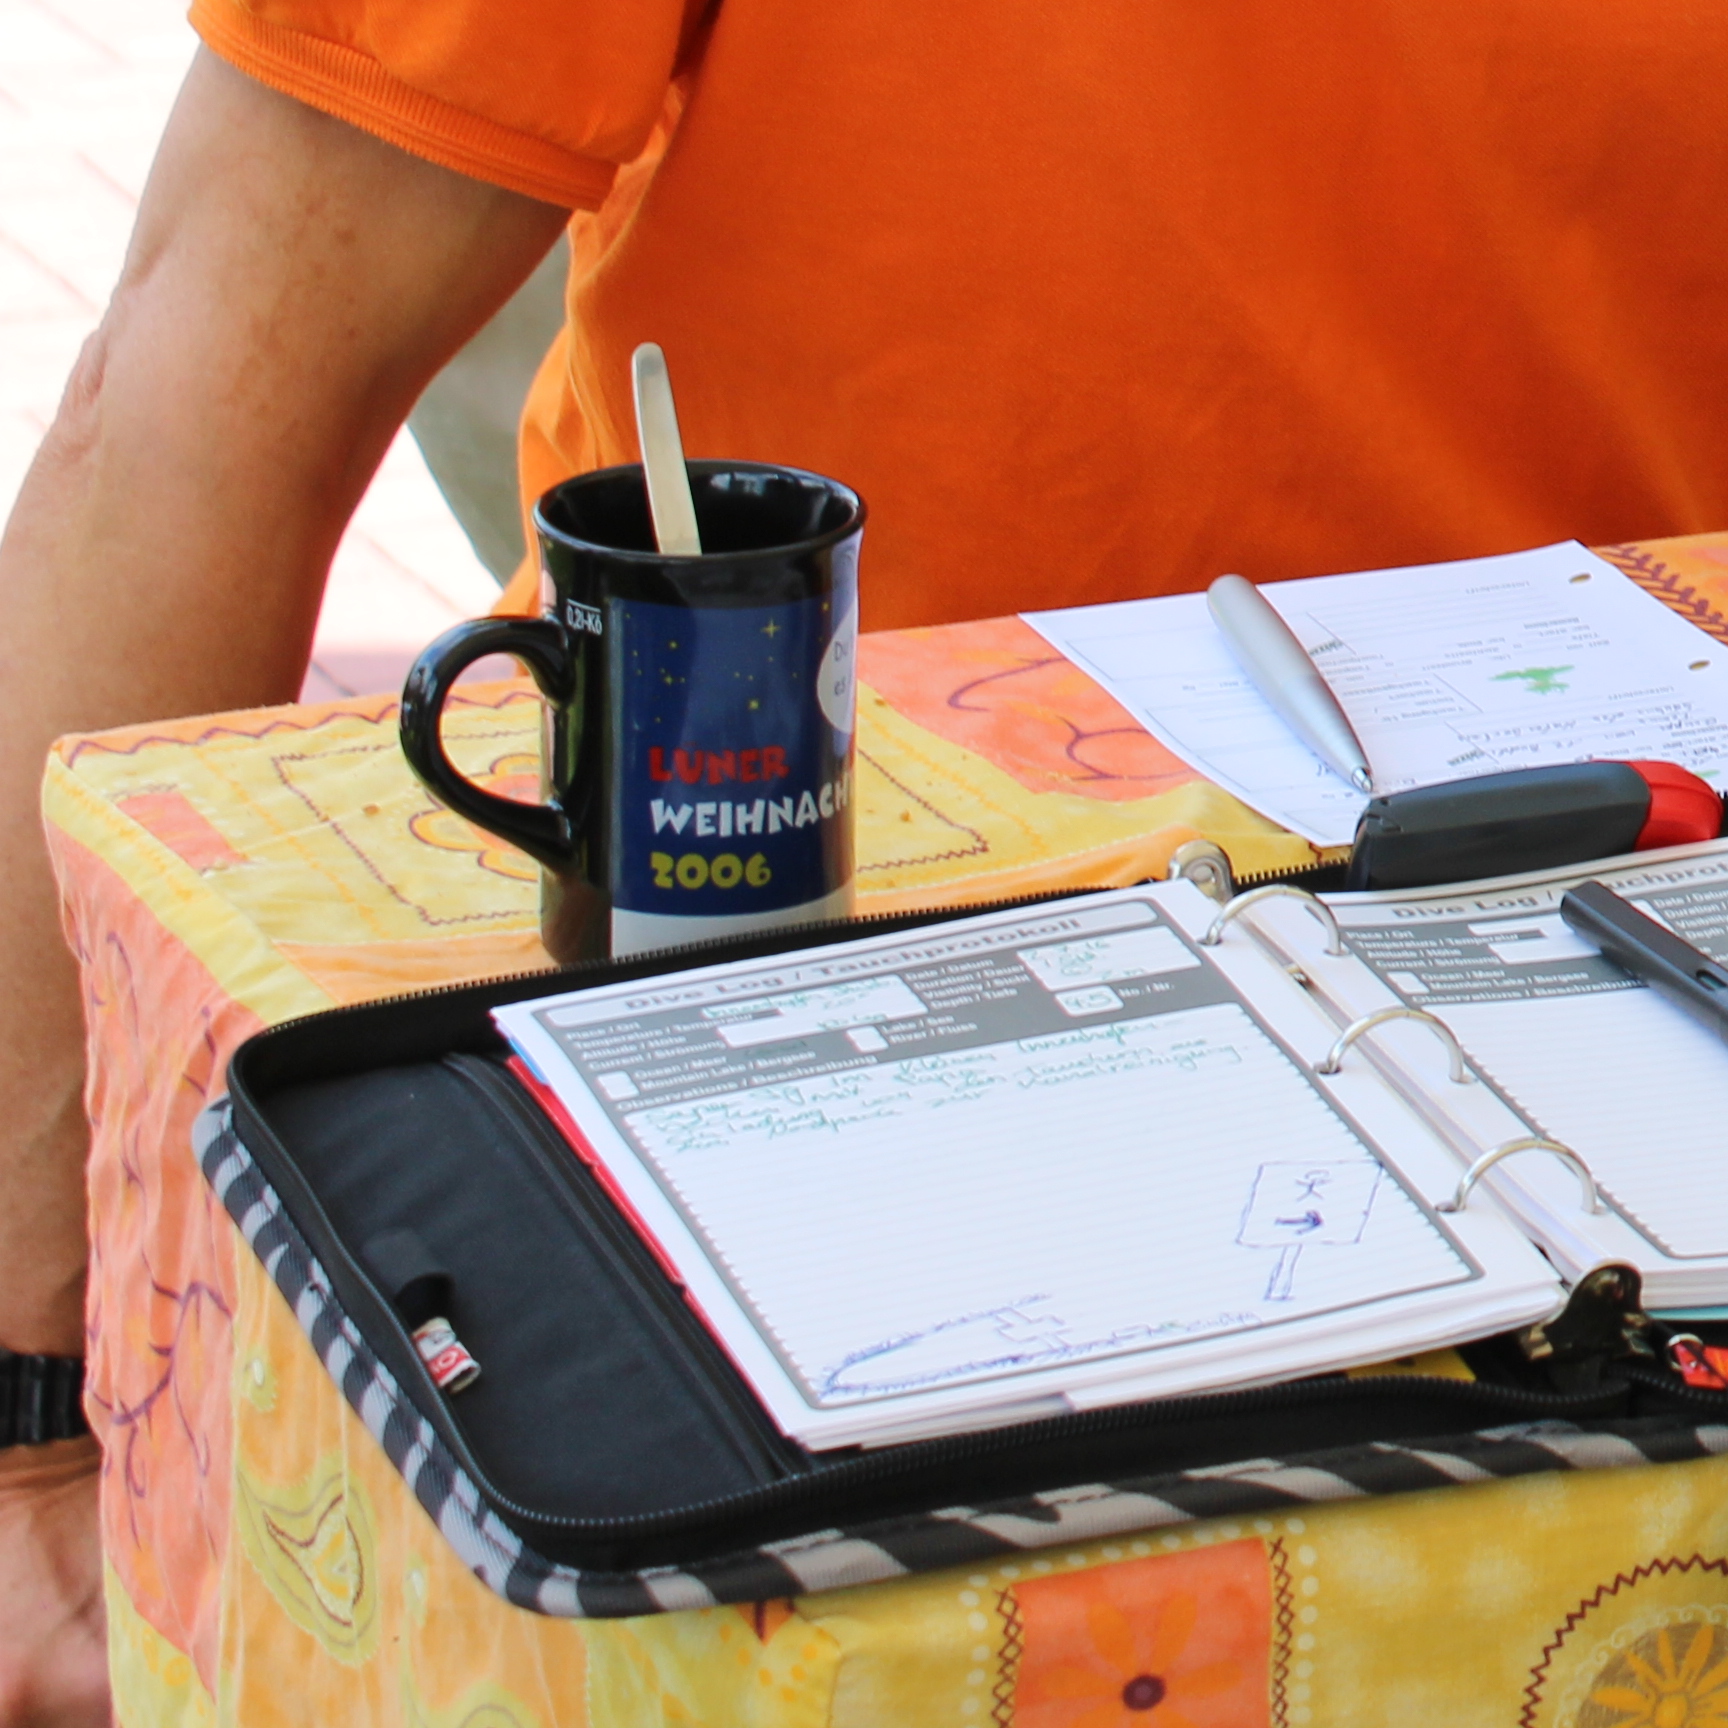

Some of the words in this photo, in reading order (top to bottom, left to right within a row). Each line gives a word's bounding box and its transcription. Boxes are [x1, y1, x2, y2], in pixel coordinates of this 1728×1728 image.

[650, 851, 772, 889] 2006
[1391, 902, 1466, 920] Dive
[1473, 893, 1540, 912] Log
[624, 990, 703, 1010] Dive
[715, 975, 785, 994] Log
[815, 918, 1082, 977] Tauchprotokoll
